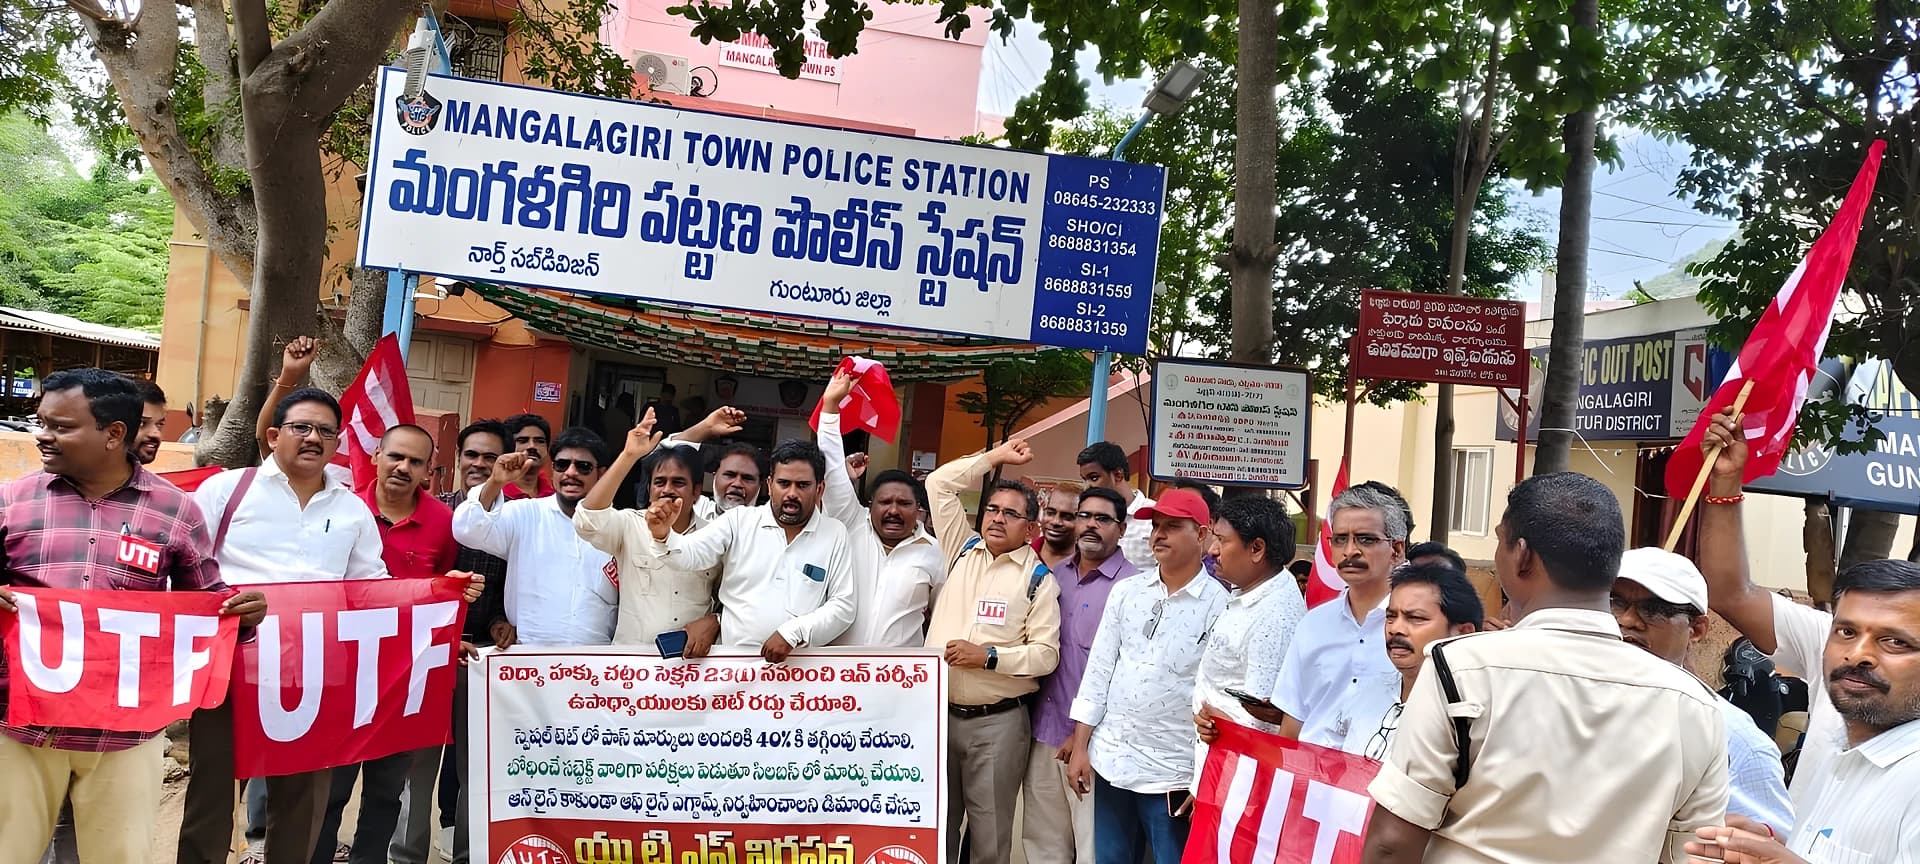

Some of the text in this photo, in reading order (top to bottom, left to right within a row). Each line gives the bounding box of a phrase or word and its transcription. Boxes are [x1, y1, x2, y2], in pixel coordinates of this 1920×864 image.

[824, 65, 836, 76] PS
[444, 100, 1030, 204] MANGALAGIRI TOWN POLICE STATION
[1089, 174, 1110, 189] PS
[1053, 191, 1155, 215] 08645-232333
[388, 149, 1027, 307] మంగళగిరి పట్టణ పోలీస్ స్టేషన్
[1066, 218, 1122, 236] SHO/CI
[467, 242, 507, 274] నార్త్
[1049, 234, 1137, 257] 8688831354
[1080, 262, 1109, 278] SI-1
[769, 279, 892, 316] గుంటూరు జిల్లా
[1044, 277, 1133, 299] 8688831559
[1076, 302, 1106, 317] SI-2
[1039, 315, 1128, 337] 8688831359
[1600, 344, 1630, 385] OUT
[1632, 339, 1673, 382] POST
[1576, 391, 1652, 410] NGALAGIRI
[1606, 415, 1662, 431] DISTRICT
[120, 540, 160, 569] UTF
[979, 601, 1006, 617] UTF
[15, 593, 220, 708] UTF
[257, 600, 460, 743] UTF
[499, 665, 544, 687] విద్యా
[550, 663, 599, 687] హక్కు
[603, 665, 650, 689] చట్టం
[654, 663, 700, 688] సెక్షన్
[760, 664, 835, 683] సవరించి
[840, 663, 870, 683] ఇన్
[875, 663, 928, 688] సర్వీస్
[711, 690, 745, 711] టెట్
[749, 693, 785, 719] రద్దు
[789, 691, 862, 712] చేయాలి.
[514, 726, 552, 750] స్పెషల్
[554, 725, 579, 745] టెట్
[582, 725, 599, 746] లో
[601, 728, 630, 746] పాస్
[633, 729, 694, 752] మార్కులు
[756, 731, 790, 748] 40%
[808, 730, 856, 754] తగ్గింపు
[859, 728, 914, 749] చేయాలి.
[507, 755, 560, 778] బోధించే
[597, 761, 642, 778] వారిగా
[645, 758, 694, 787] పరీక్షలు
[697, 761, 750, 780] పెడుతూ
[753, 761, 799, 781] సిలబస్
[802, 760, 820, 780] లో
[824, 763, 869, 786] మార్పు
[871, 760, 924, 783] చేయాలి.
[508, 788, 532, 807] ఆన్
[534, 787, 557, 814] లైన్
[560, 791, 617, 810] కాకుండా
[620, 792, 644, 813] ఆఫ్
[646, 792, 669, 817] లైన్
[722, 793, 819, 819] నిర్వహించాలని
[822, 793, 881, 814] డిమాండ్
[885, 793, 920, 822] చేస్తూ
[1217, 753, 1371, 864] UT
